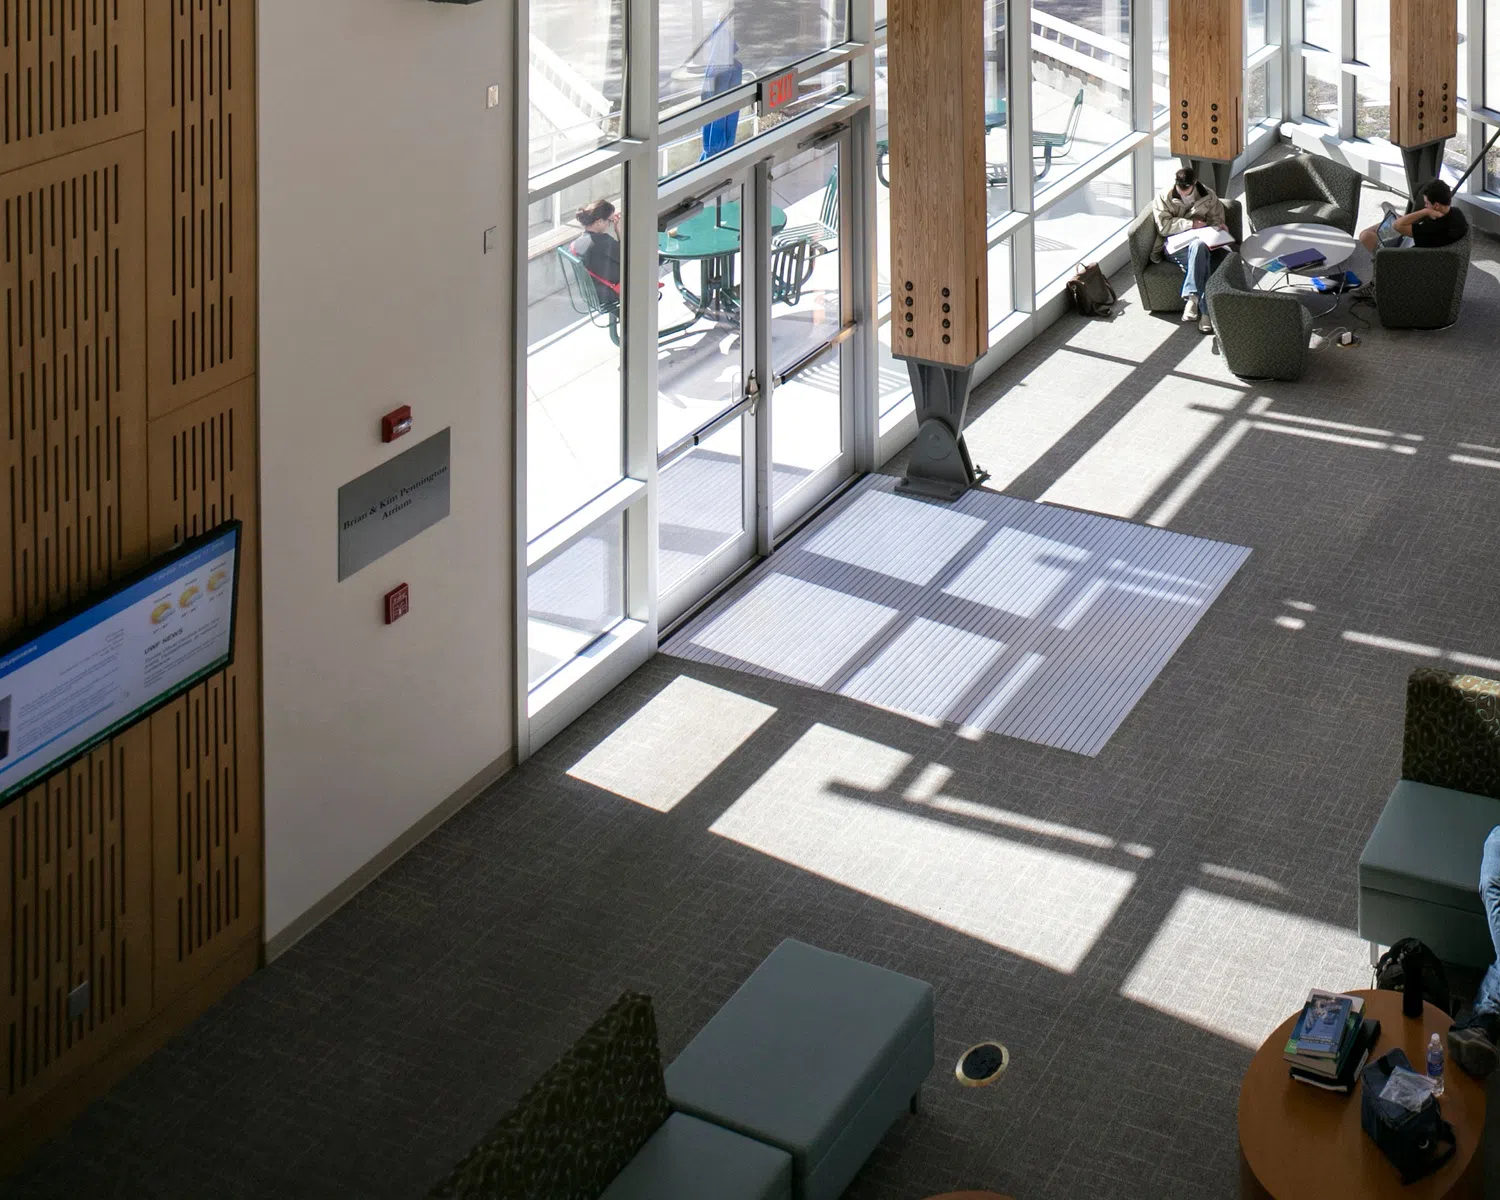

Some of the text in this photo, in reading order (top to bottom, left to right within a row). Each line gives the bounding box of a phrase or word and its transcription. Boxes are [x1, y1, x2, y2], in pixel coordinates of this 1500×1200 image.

[768, 73, 793, 108] EXIT
[343, 465, 447, 530] Brian & Kim Pennington
[381, 499, 412, 520] Atrium
[162, 627, 184, 644] NEWS
